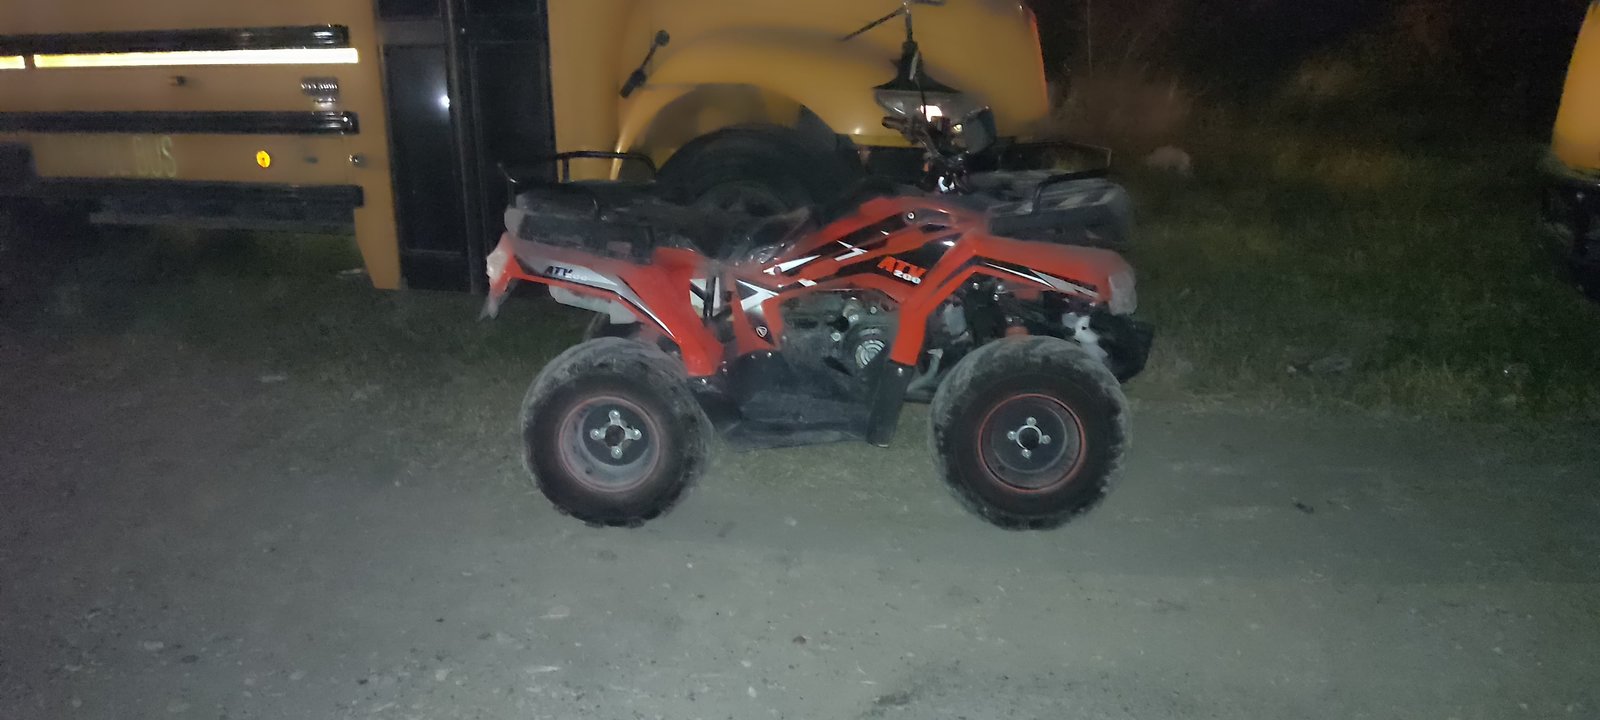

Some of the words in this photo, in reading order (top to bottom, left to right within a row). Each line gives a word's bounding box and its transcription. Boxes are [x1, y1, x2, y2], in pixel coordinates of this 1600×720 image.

[544, 265, 573, 277] ATV
[877, 255, 927, 278] ATV
[893, 269, 922, 285] 200
